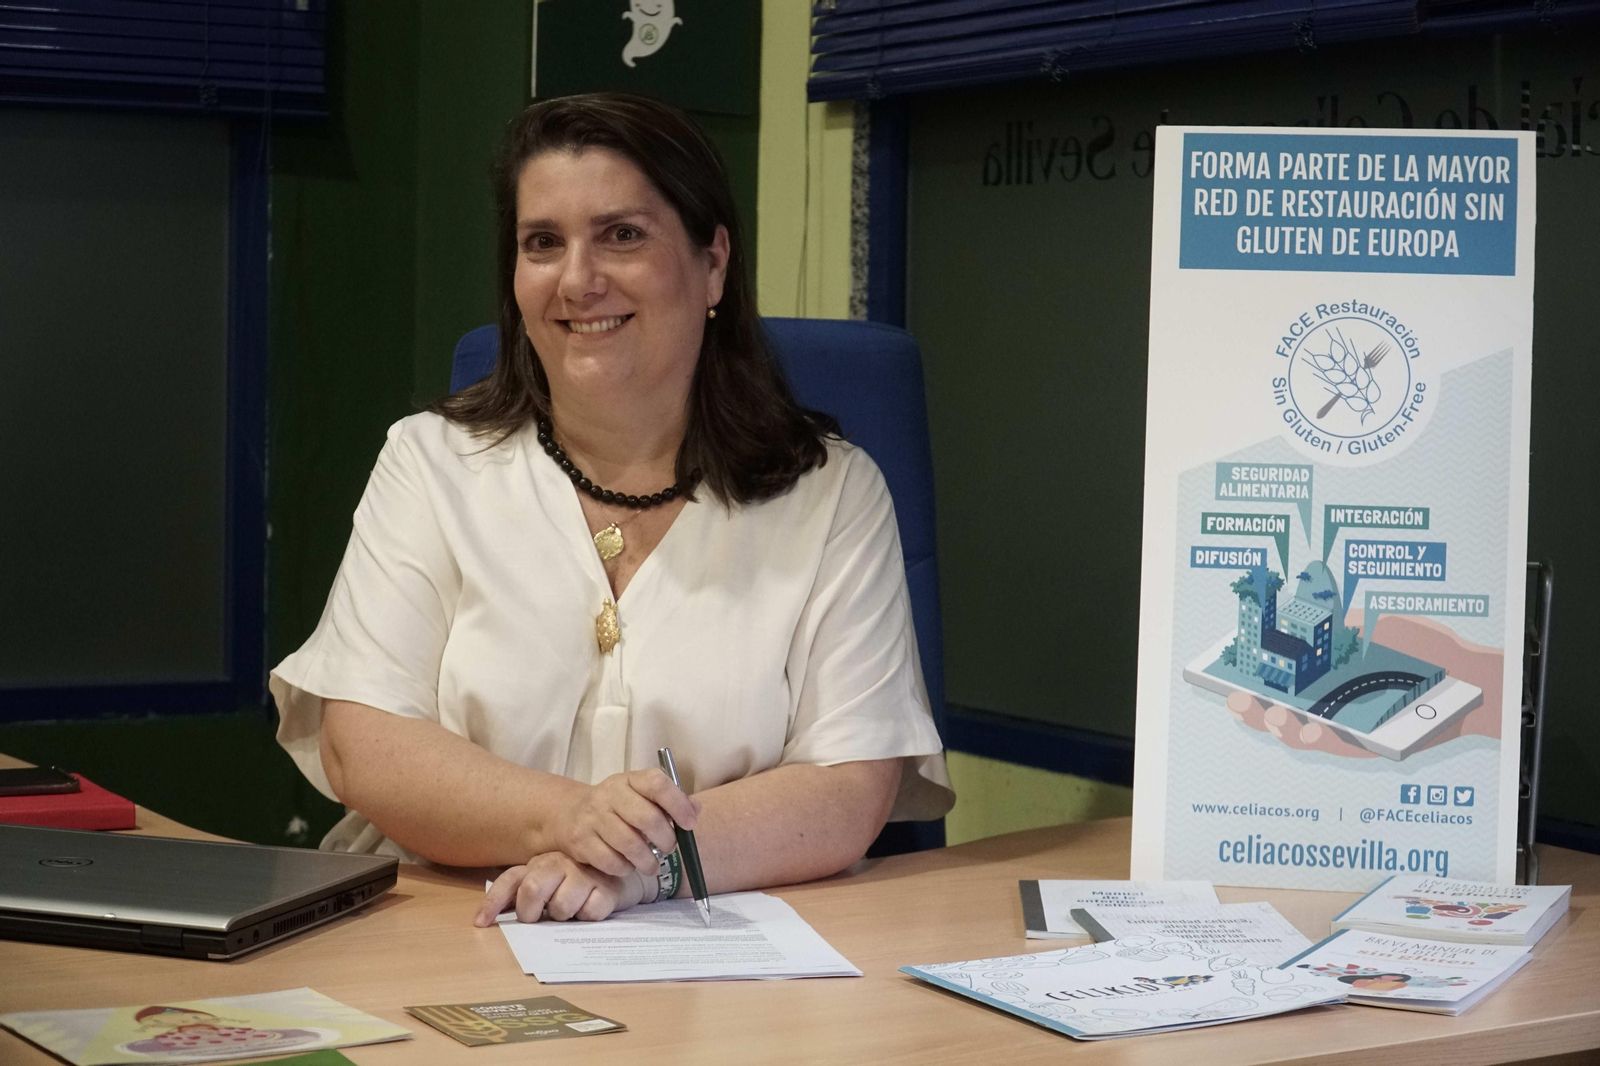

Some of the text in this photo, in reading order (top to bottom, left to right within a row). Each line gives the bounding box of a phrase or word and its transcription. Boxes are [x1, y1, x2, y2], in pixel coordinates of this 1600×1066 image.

[1191, 151, 1510, 184] FORMA PARTE DE LA MAYOR
[1194, 187, 1504, 221] RED DE RESTAURACIÓN SIN
[1237, 226, 1460, 258] GLUTEN DE EUROPA
[1275, 299, 1420, 359] FACE Restauración
[1272, 377, 1287, 406] Sin
[1283, 408, 1332, 452] Gluten
[1347, 382, 1427, 455] Gluten-Free
[1231, 467, 1310, 482] SEGURIDAD
[1220, 483, 1309, 499] ALIMENTARIA
[1206, 515, 1285, 533] FORMACIÓN
[1330, 508, 1424, 526] INTEGRACIÓN
[1195, 548, 1262, 566] DIFUSIÓN
[1348, 543, 1427, 560] CONTROL Y
[1348, 560, 1442, 577] SEGUIMIENTO
[1369, 595, 1485, 613] ASESORAMIENTO
[1192, 803, 1473, 825] www.celiacos.org @FACEceliacos
[1218, 834, 1449, 878] celiacossevilla.org
[1365, 936, 1407, 948] BREVE
[1409, 943, 1476, 955] MANUAL
[1413, 950, 1457, 959] DIETA
[1357, 950, 1476, 965] sin gluten
[1045, 982, 1176, 1001] CELIKIDS
